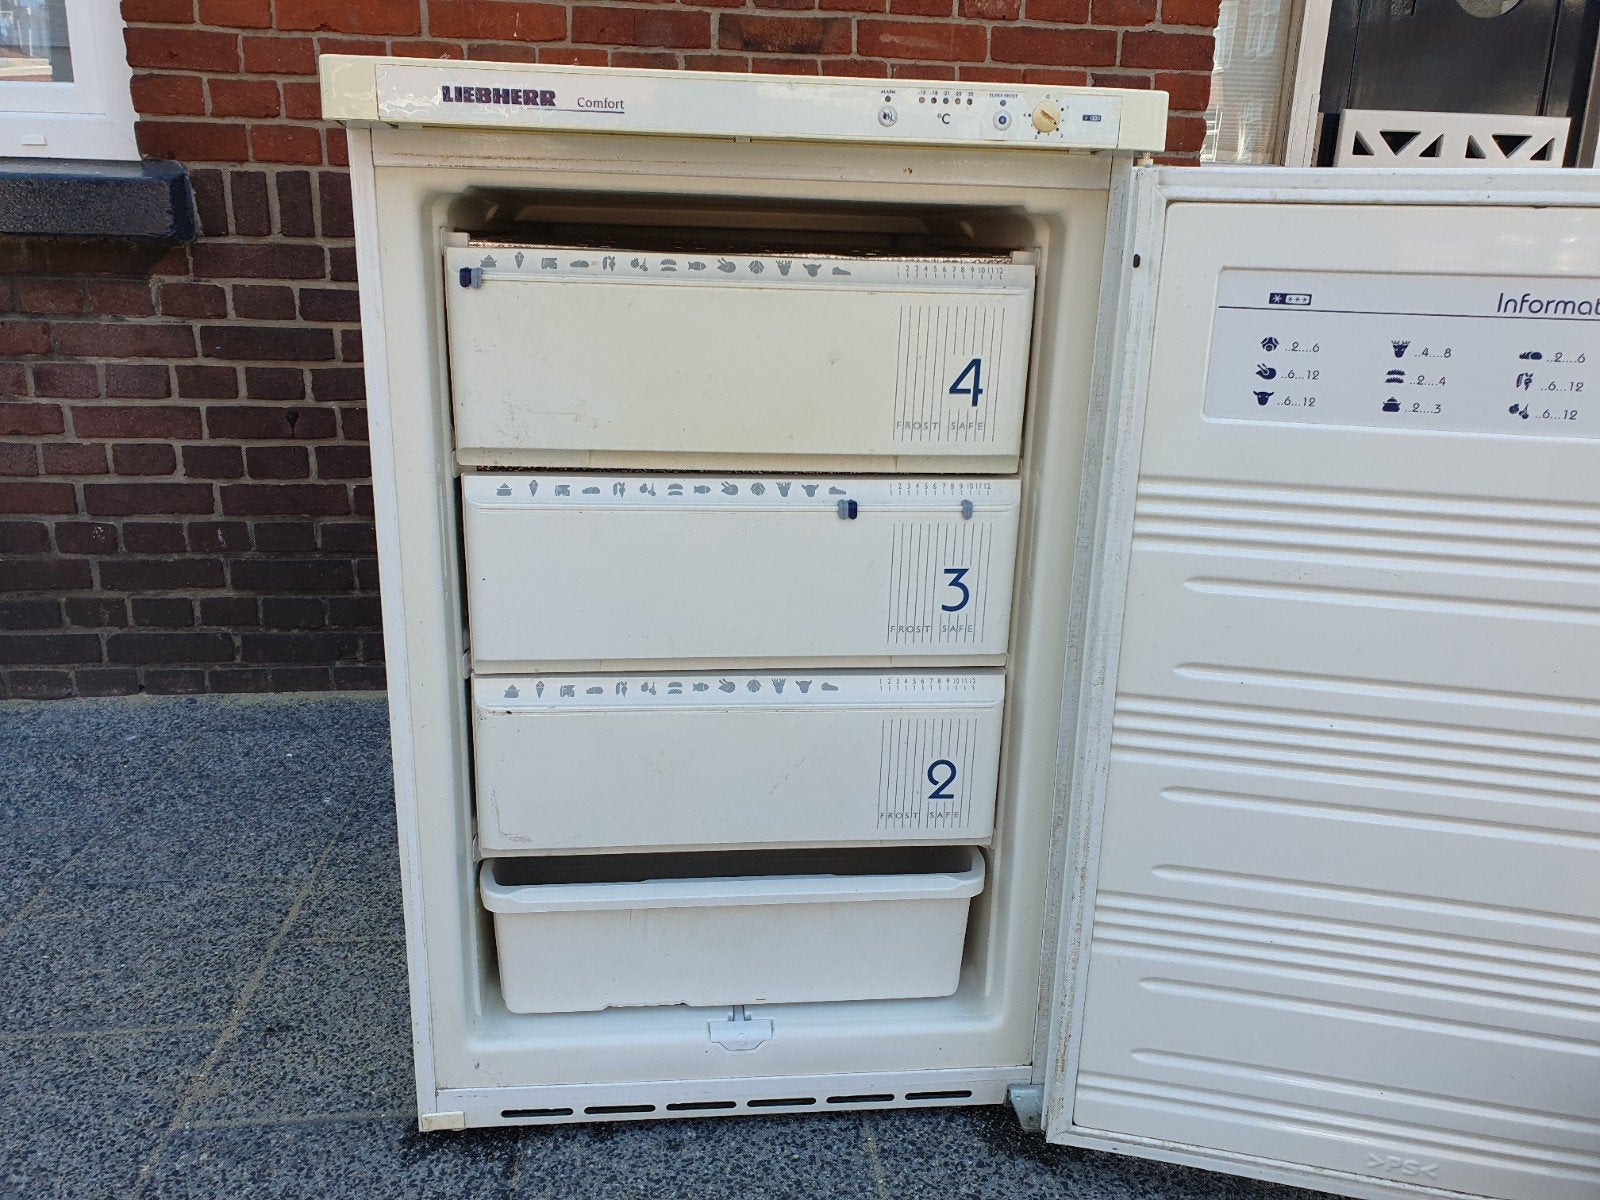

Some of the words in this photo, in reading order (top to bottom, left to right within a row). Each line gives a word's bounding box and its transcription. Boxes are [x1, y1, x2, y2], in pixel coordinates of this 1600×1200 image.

[442, 85, 556, 107] LIEBHERR
[577, 96, 625, 110] Comfort
[949, 358, 984, 407] 4
[896, 421, 938, 430] FROST
[950, 422, 983, 430] SAFE
[941, 568, 970, 612] 3
[890, 625, 930, 633] FROST
[942, 624, 973, 633] SAFE
[927, 759, 957, 799] 2
[929, 811, 960, 819] SAFE
